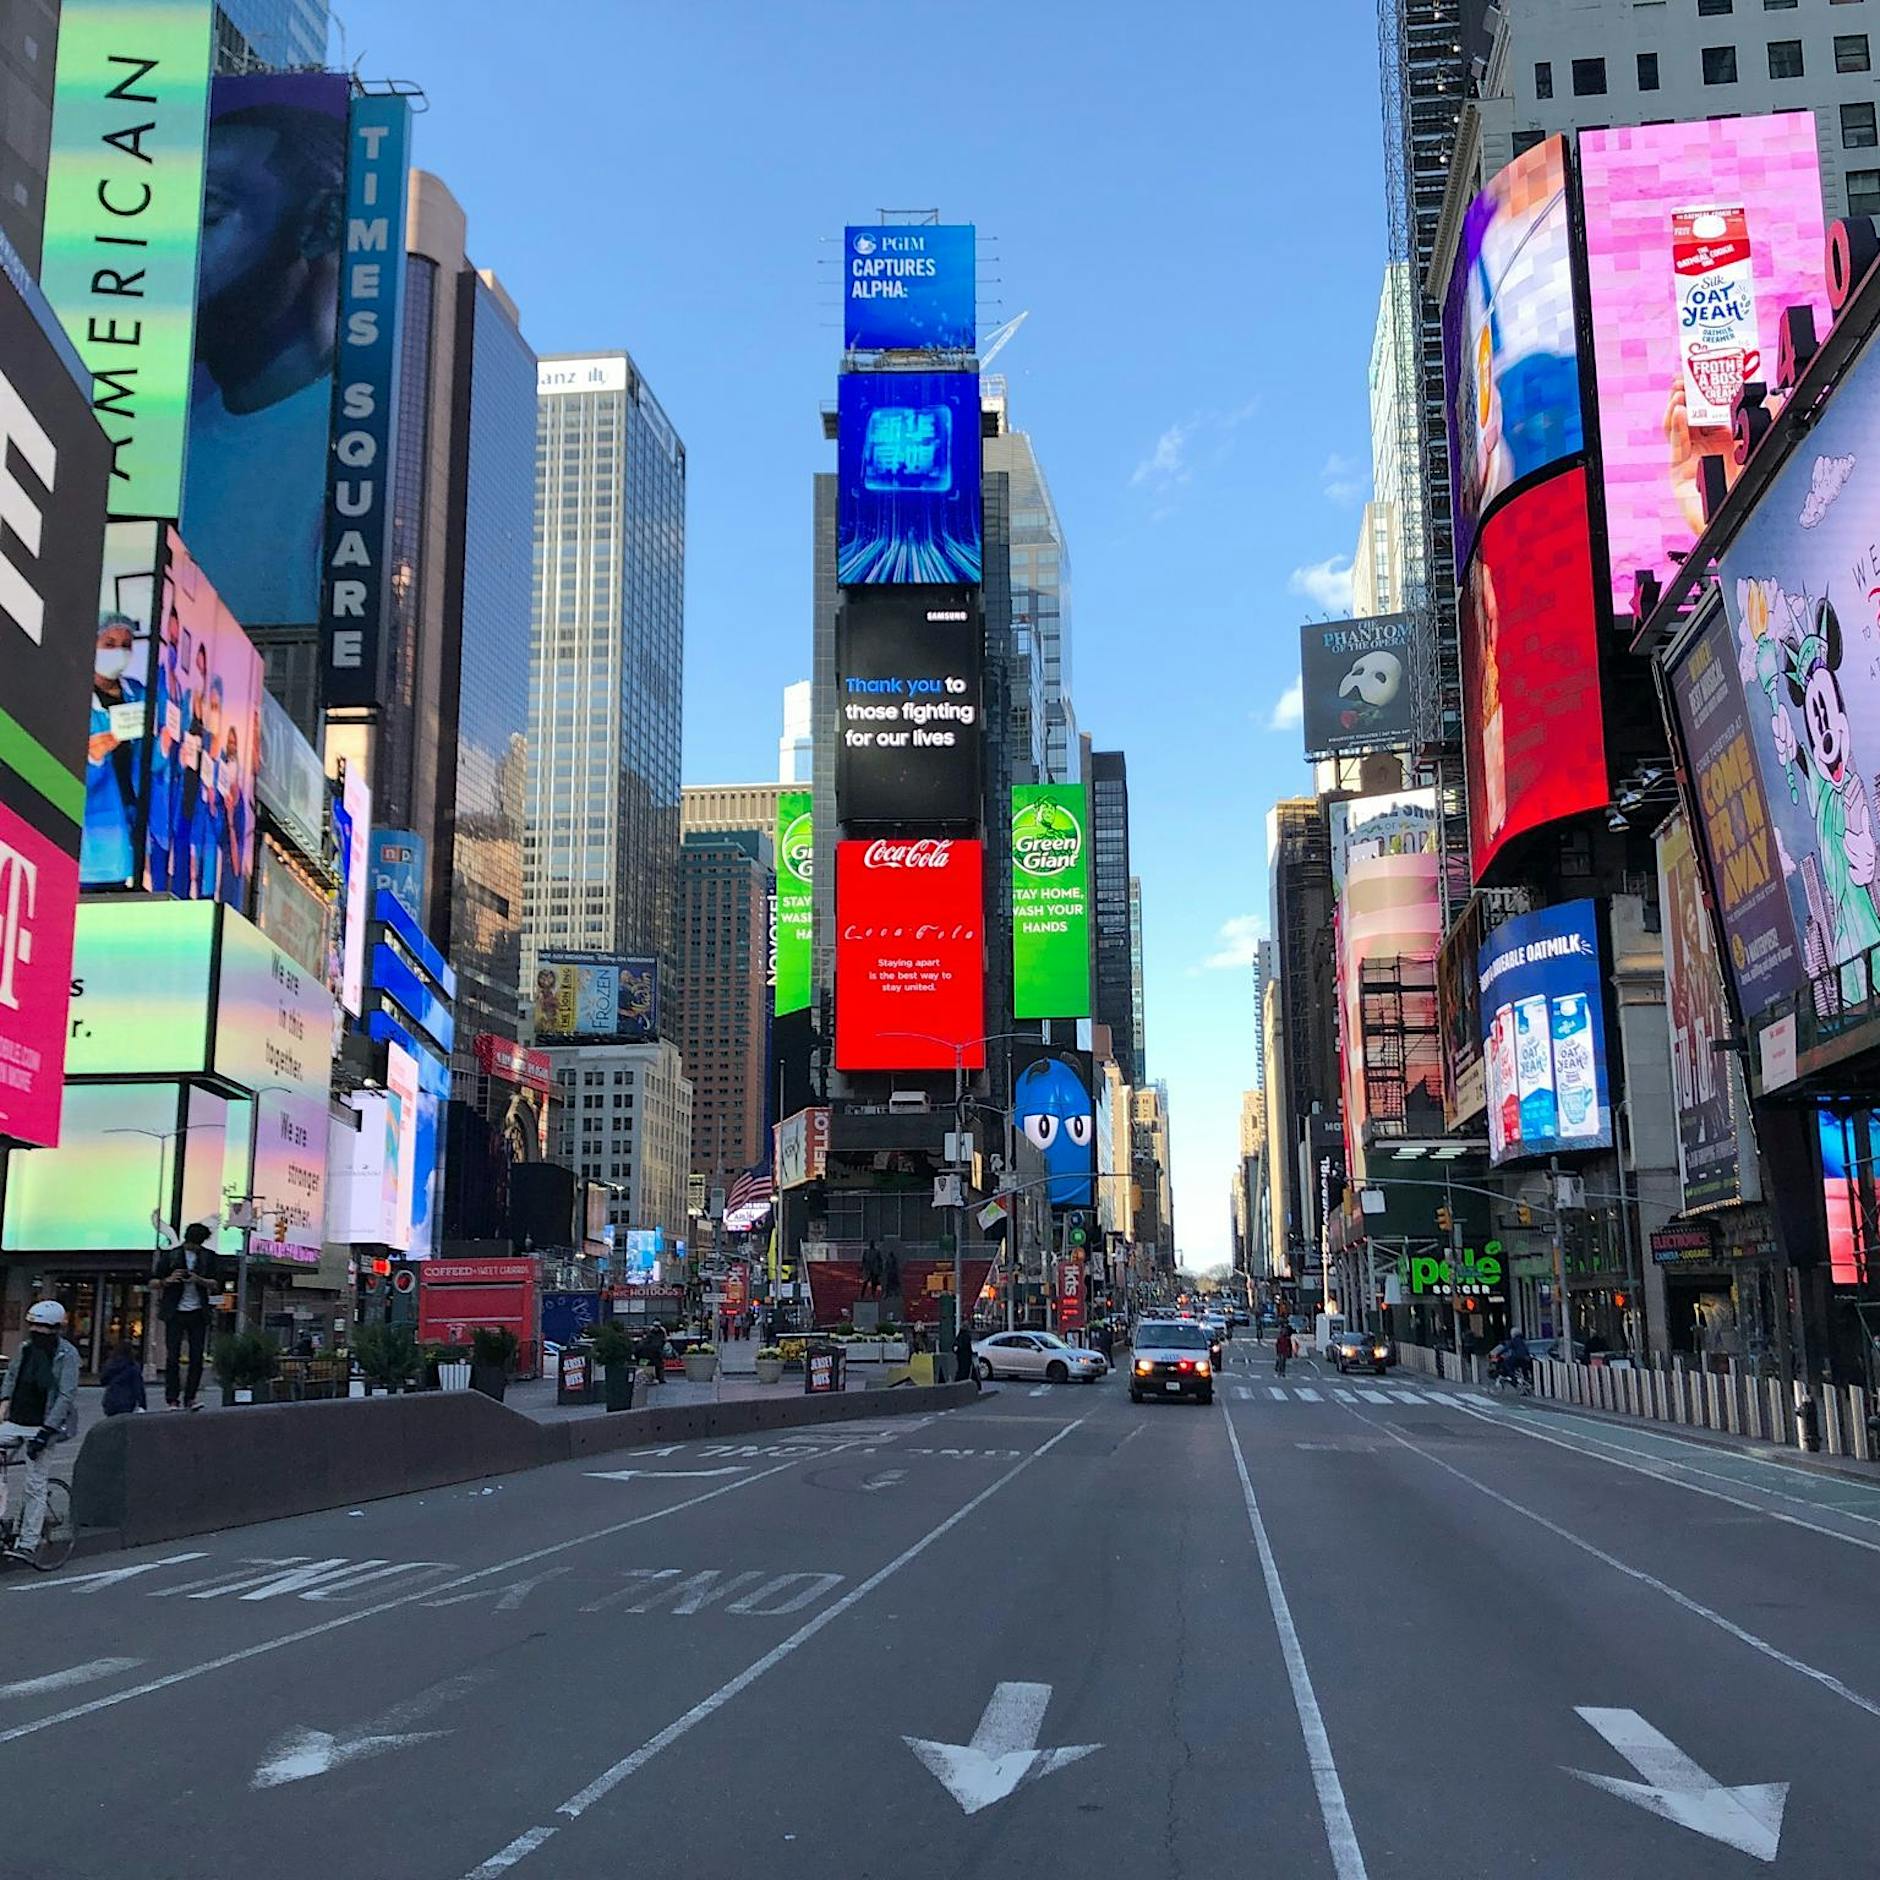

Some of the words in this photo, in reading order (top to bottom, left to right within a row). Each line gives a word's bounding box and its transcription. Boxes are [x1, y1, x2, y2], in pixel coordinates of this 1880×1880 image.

[346, 125, 390, 347] TIMES
[881, 236, 925, 251] PGIM
[851, 258, 936, 277] CAPTURES
[1701, 275, 1725, 290] Silk
[1692, 281, 1735, 304] OAT
[1682, 301, 1744, 327] YEAH
[1702, 333, 1736, 344] CREAMER
[1693, 359, 1736, 376] FROTH
[1698, 374, 1709, 391] A
[1710, 371, 1743, 386] BOSS
[331, 382, 377, 668] SQUARE
[926, 611, 968, 622] SAMSUNG
[1322, 623, 1411, 647] PHANTOM
[1348, 641, 1370, 652] THE
[1370, 637, 1406, 650] OPERA
[845, 677, 903, 694] Thank
[906, 679, 941, 698] you
[944, 676, 967, 694] to
[845, 703, 899, 720] those
[901, 701, 975, 725] fighting
[845, 729, 874, 747] for
[876, 732, 911, 747] our
[912, 728, 956, 747] lives
[1701, 732, 1754, 817] COME
[1015, 835, 1077, 852] Green
[1022, 851, 1079, 869] Giant
[1723, 826, 1772, 913] AWAY
[1046, 903, 1084, 915] YOUR
[1022, 921, 1068, 933] HANDS
[1526, 932, 1581, 962] OATMILK
[271, 949, 284, 985] We
[286, 970, 300, 996] are
[877, 958, 914, 968] Staying
[914, 958, 941, 968] apart
[868, 971, 877, 980] is
[879, 971, 895, 980] the
[897, 971, 918, 980] best
[919, 972, 939, 982] way
[941, 971, 953, 980] to
[881, 983, 902, 993] stay
[559, 990, 573, 1011] LION
[591, 968, 612, 1029] FROZEN
[278, 998, 287, 1030] in
[288, 1007, 304, 1041] this
[280, 1110, 293, 1142] We
[295, 1125, 307, 1148] are
[423, 1266, 474, 1277] COFFEED
